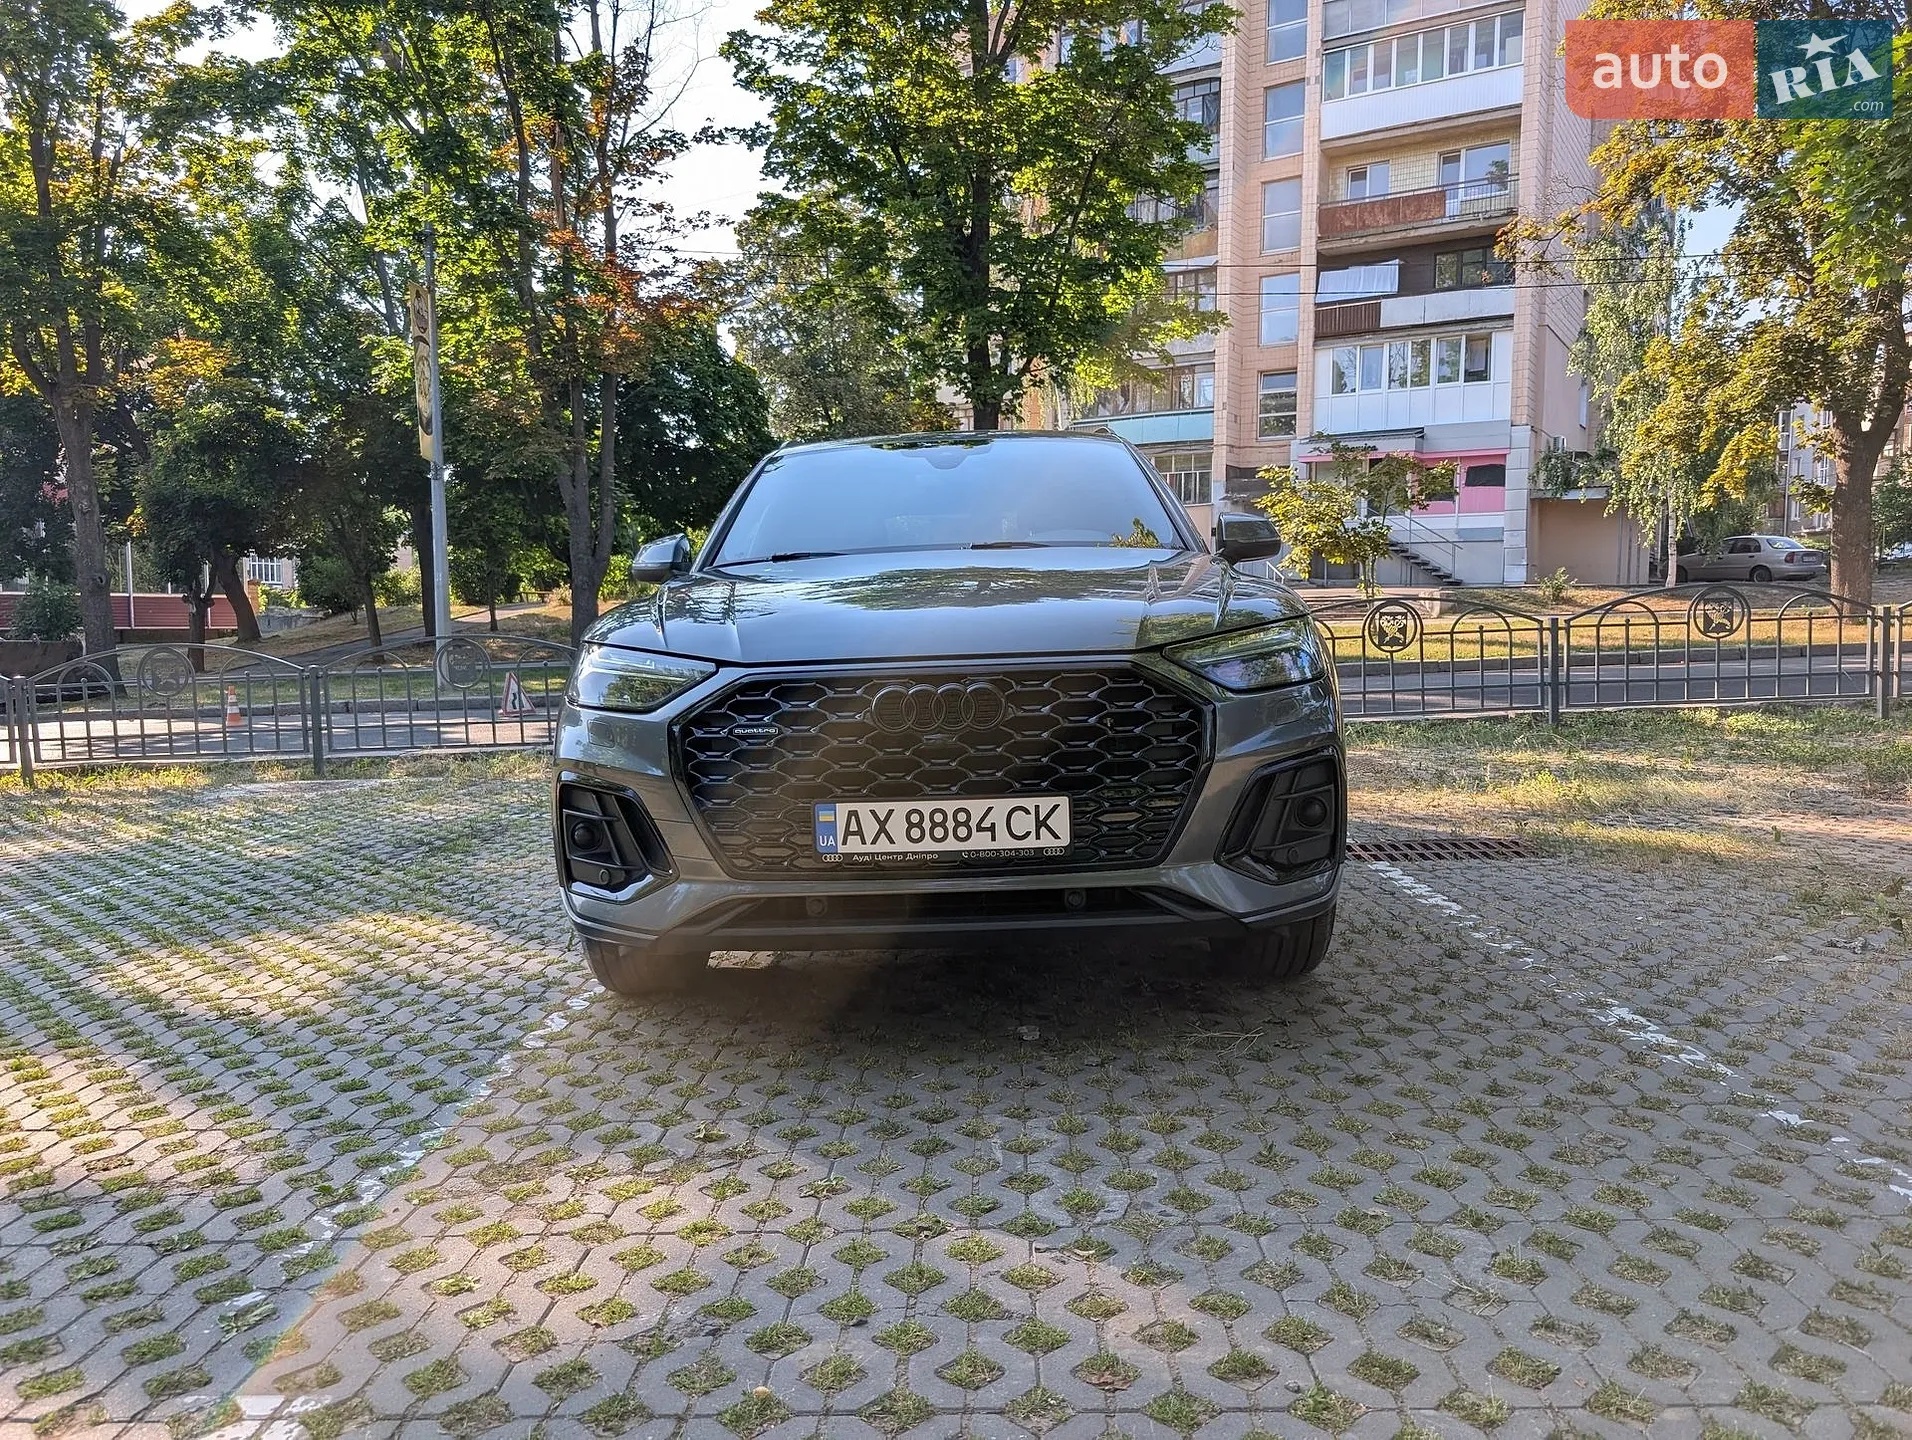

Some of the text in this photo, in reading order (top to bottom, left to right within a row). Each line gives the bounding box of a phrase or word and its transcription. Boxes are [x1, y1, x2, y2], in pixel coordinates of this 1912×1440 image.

[841, 803, 1062, 846] AX 8884 CK
[819, 835, 836, 847] UA
[852, 852, 939, 863] Ауді Центр Дніпро
[970, 849, 1035, 858] 0-800-304-303
